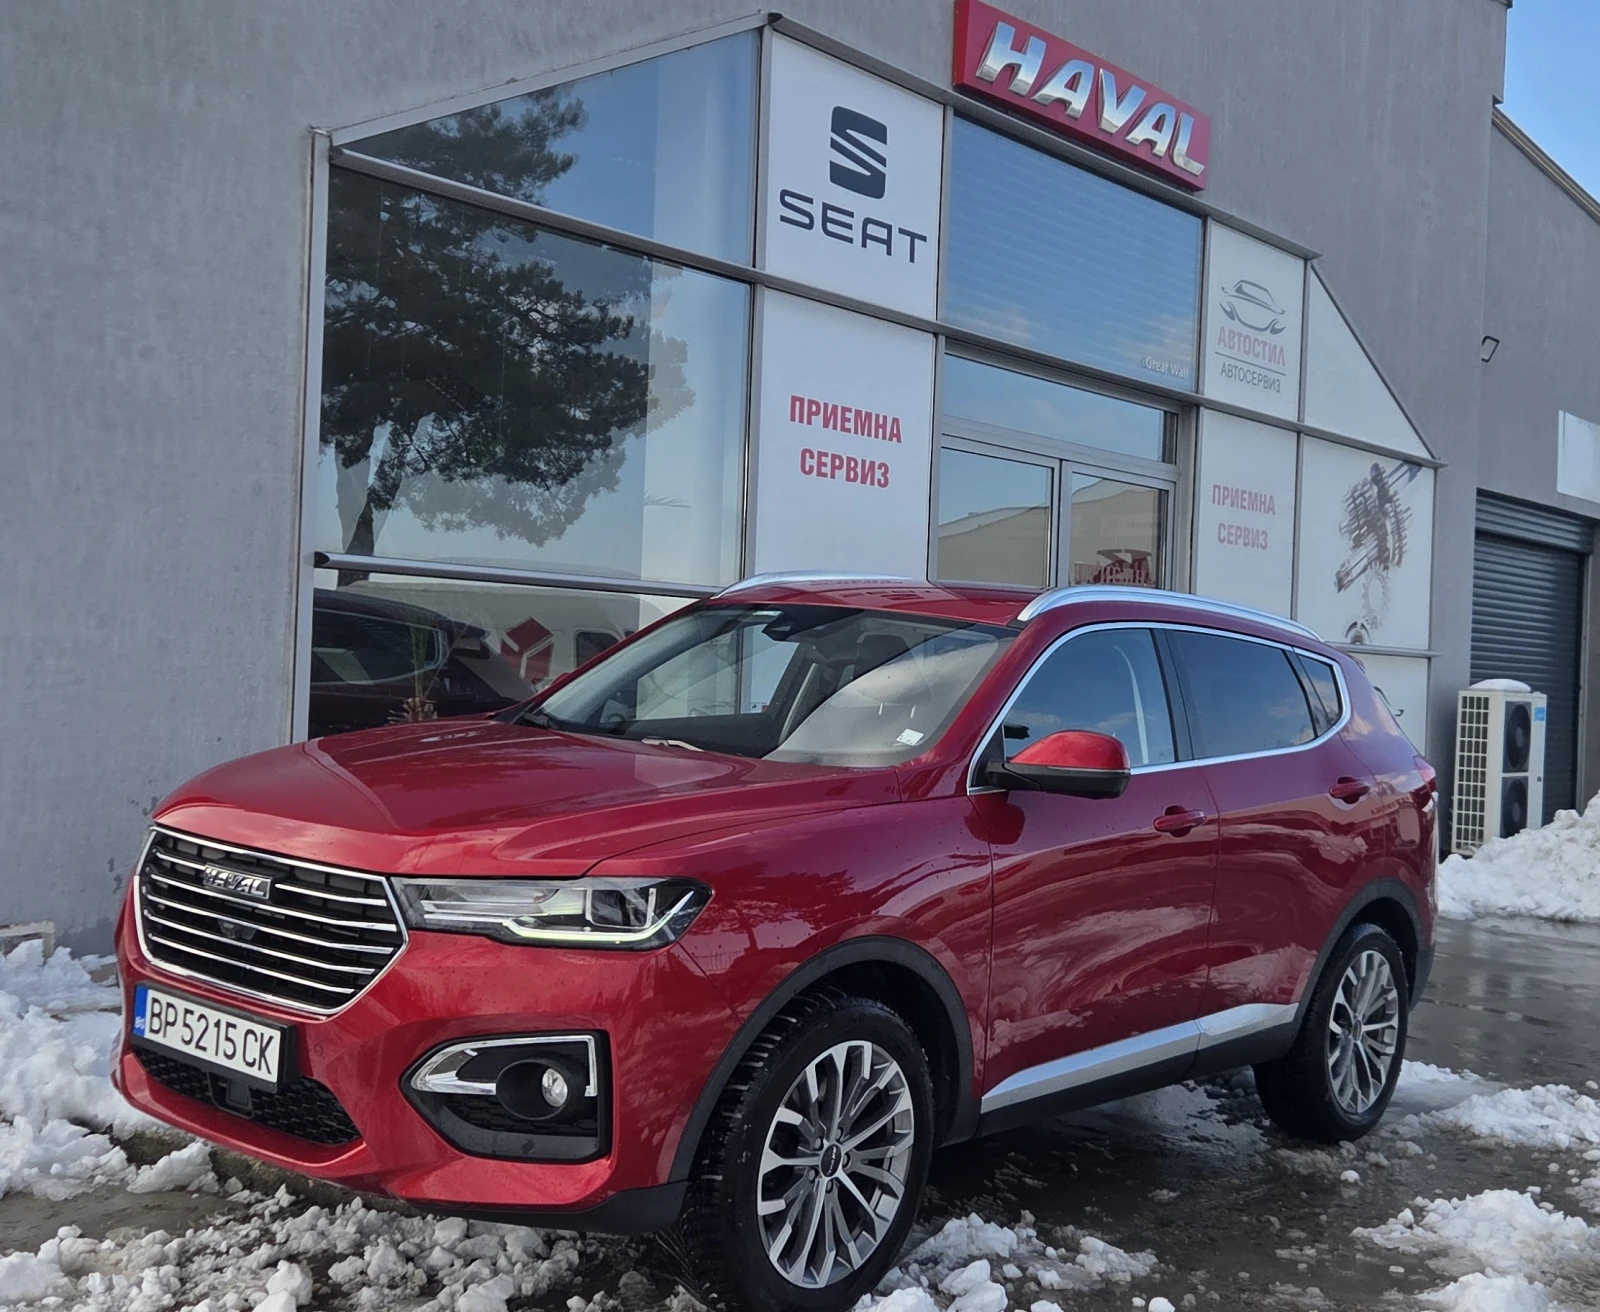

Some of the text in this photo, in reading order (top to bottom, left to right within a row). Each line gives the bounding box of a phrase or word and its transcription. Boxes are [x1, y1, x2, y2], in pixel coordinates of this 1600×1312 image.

[976, 20, 1205, 176] HAVAL
[779, 188, 927, 264] SEAT
[1217, 325, 1286, 367] АВТОСТИЛ
[1145, 356, 1189, 379] Great Wall
[1220, 361, 1281, 393] АВТОСЕРВИЗ
[789, 394, 902, 444] ПРИЕМНА
[800, 447, 890, 488] СЕРВИЗ
[1212, 483, 1276, 516] ПРИЕМНА
[1217, 522, 1269, 551] СЕРВИЗ
